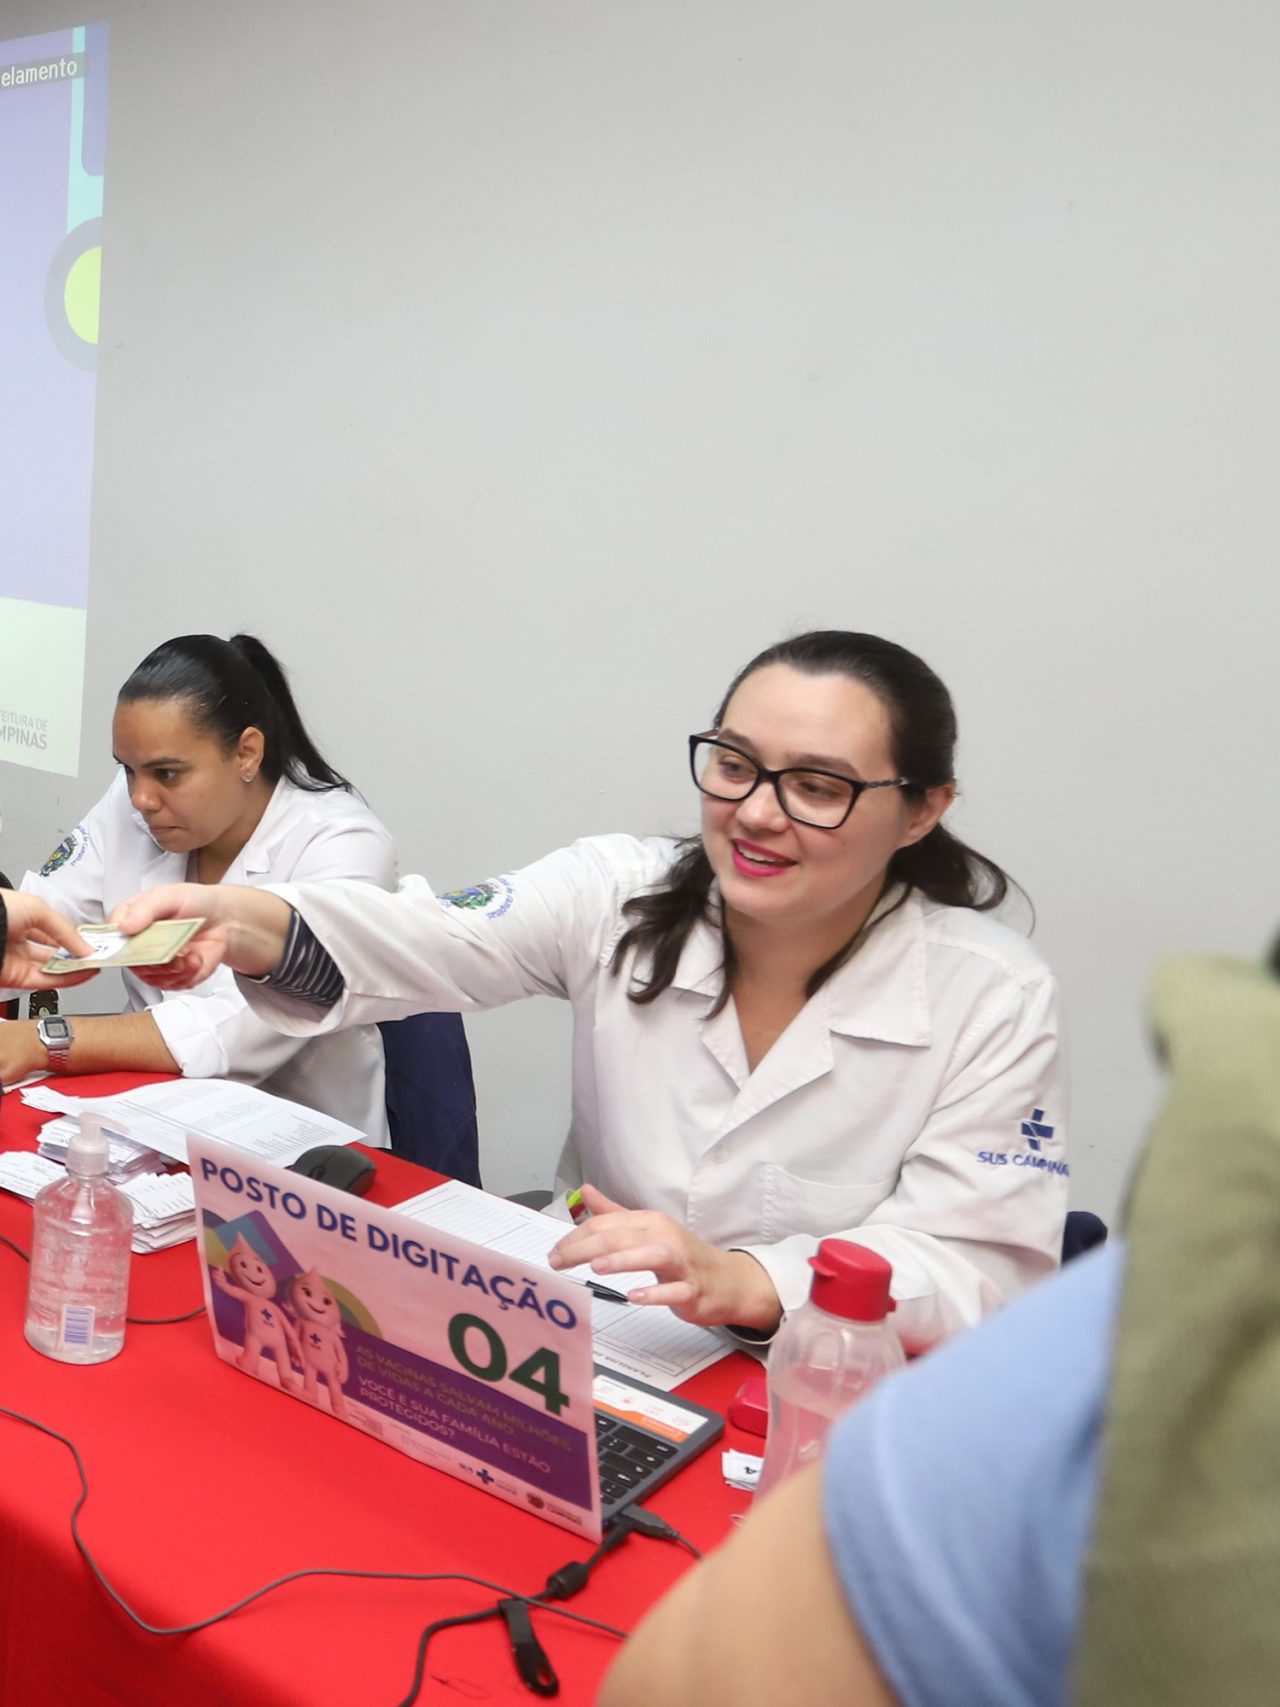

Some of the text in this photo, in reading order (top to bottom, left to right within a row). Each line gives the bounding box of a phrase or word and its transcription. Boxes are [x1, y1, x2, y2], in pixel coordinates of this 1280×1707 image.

[35, 718, 49, 732] DE
[976, 1151, 1008, 1166] SUS
[200, 1156, 577, 1330] POSTO DE DIGITAÇÃO
[447, 1312, 571, 1417] 04
[359, 1386, 456, 1438] PROTEGIDOS?
[398, 1393, 408, 1407] E
[409, 1399, 439, 1420] SUA
[440, 1413, 500, 1449] FAMÍLIA
[502, 1442, 552, 1473] ESTÃO
